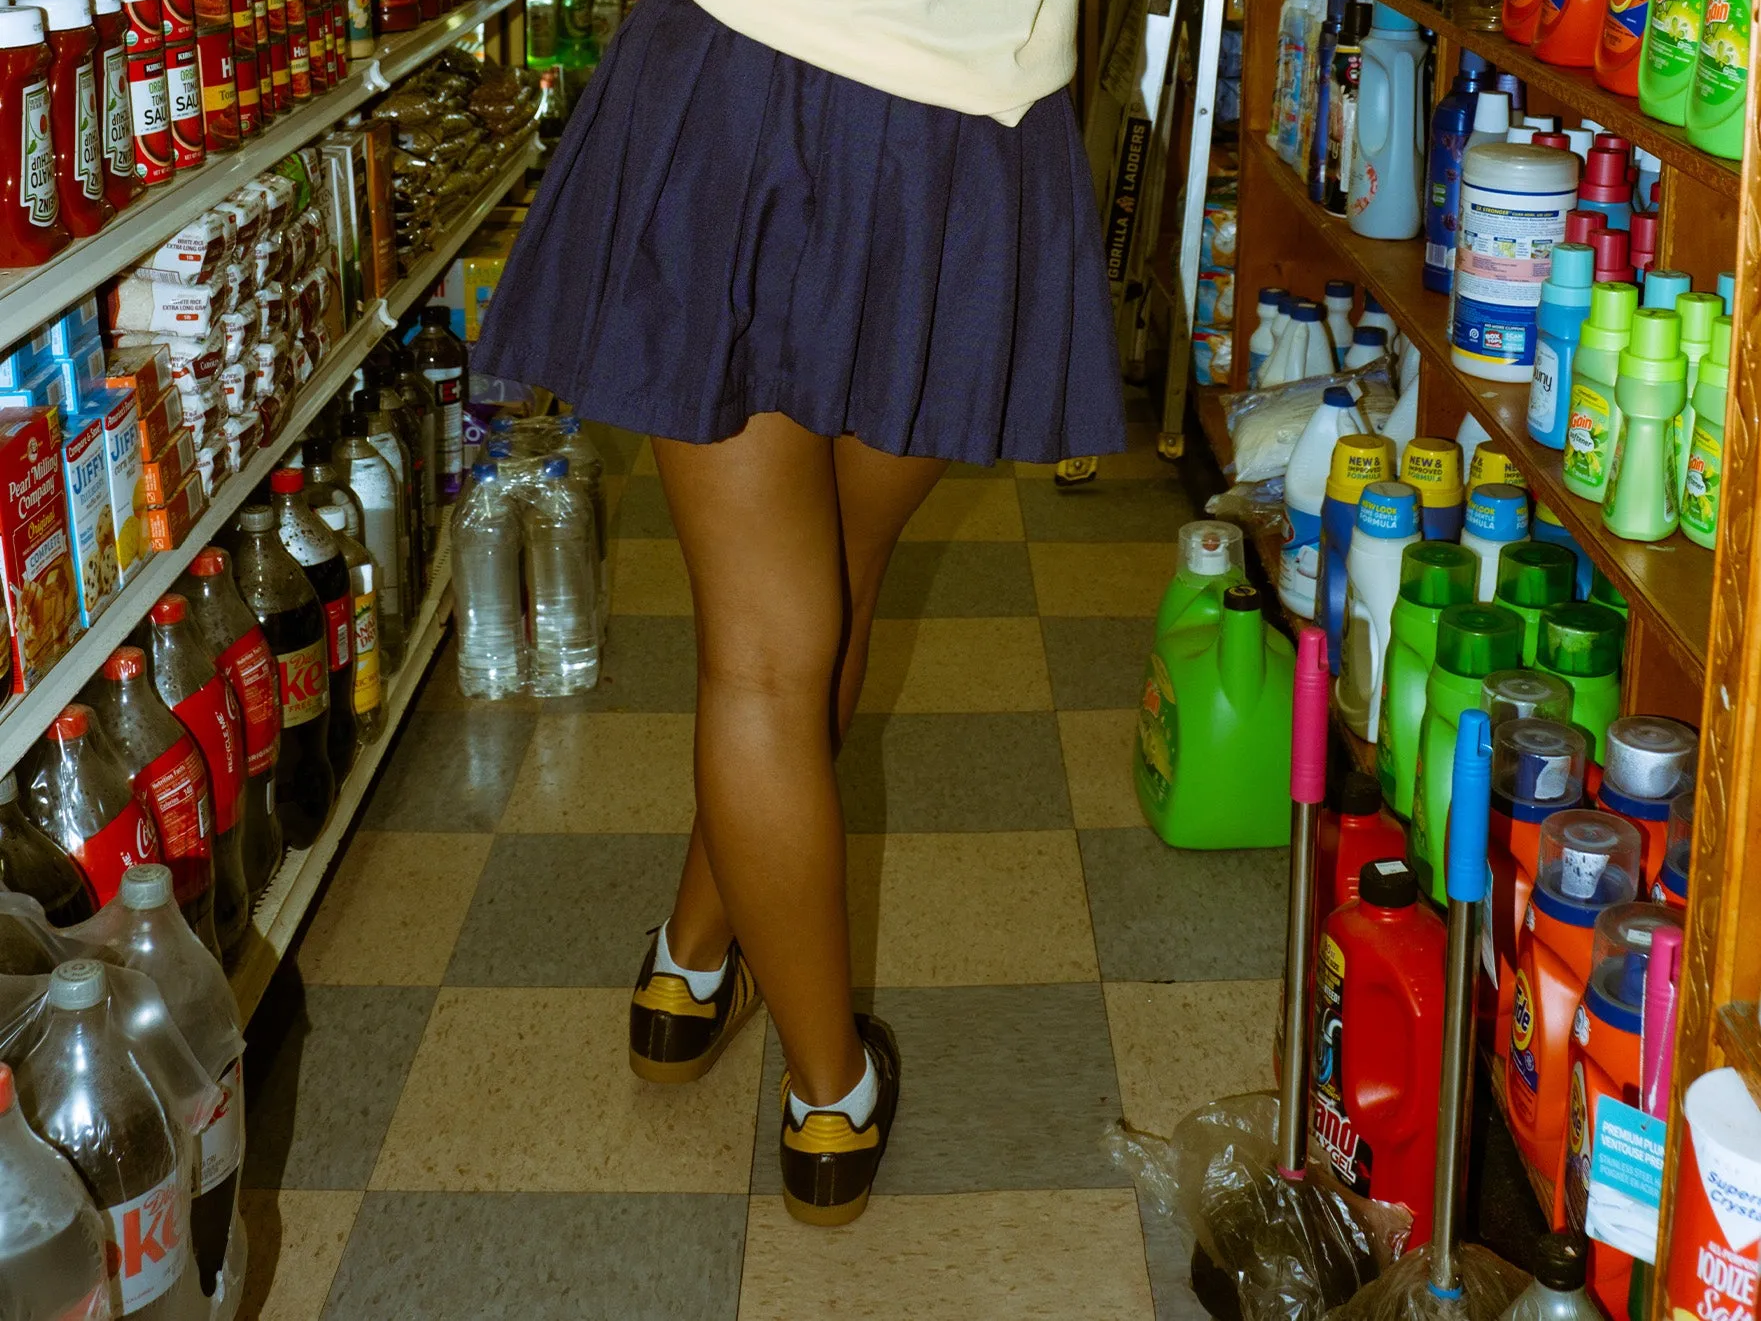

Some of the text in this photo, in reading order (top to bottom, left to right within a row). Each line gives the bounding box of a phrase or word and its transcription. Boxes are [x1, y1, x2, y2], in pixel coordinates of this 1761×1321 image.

[1108, 124, 1146, 279] GORILLA LADDERS
[1483, 207, 1509, 216] STRONGER
[1571, 412, 1593, 430] Gain
[68, 437, 86, 458] Compare
[72, 447, 106, 495] JIFFY
[1347, 465, 1382, 474] IMPROVED
[1348, 455, 1381, 467] NEW &
[1408, 465, 1443, 476] IMPROVED
[1409, 455, 1442, 468] NEW &
[9, 452, 59, 503] Pearl Milling
[1346, 472, 1381, 481] FORMULA
[1407, 471, 1442, 482] FORMULA
[18, 477, 55, 520] Company
[1361, 499, 1397, 515] NEW LOOK
[1476, 504, 1496, 516] LOOK
[27, 506, 56, 540] Original
[1359, 514, 1398, 529] FORMULA
[1374, 510, 1398, 523] GENTLE
[29, 533, 62, 568] COMPLETE
[216, 712, 234, 774] RECYCLE ME
[152, 764, 186, 789] Nutrition Facts
[159, 784, 194, 812] Calories 140
[1313, 1104, 1360, 1161] ano
[1601, 1119, 1642, 1143] PREMIUM
[1601, 1134, 1645, 1162] VENTOUSE
[1330, 1148, 1356, 1184] GEL
[1697, 1246, 1757, 1307] IODIZE
